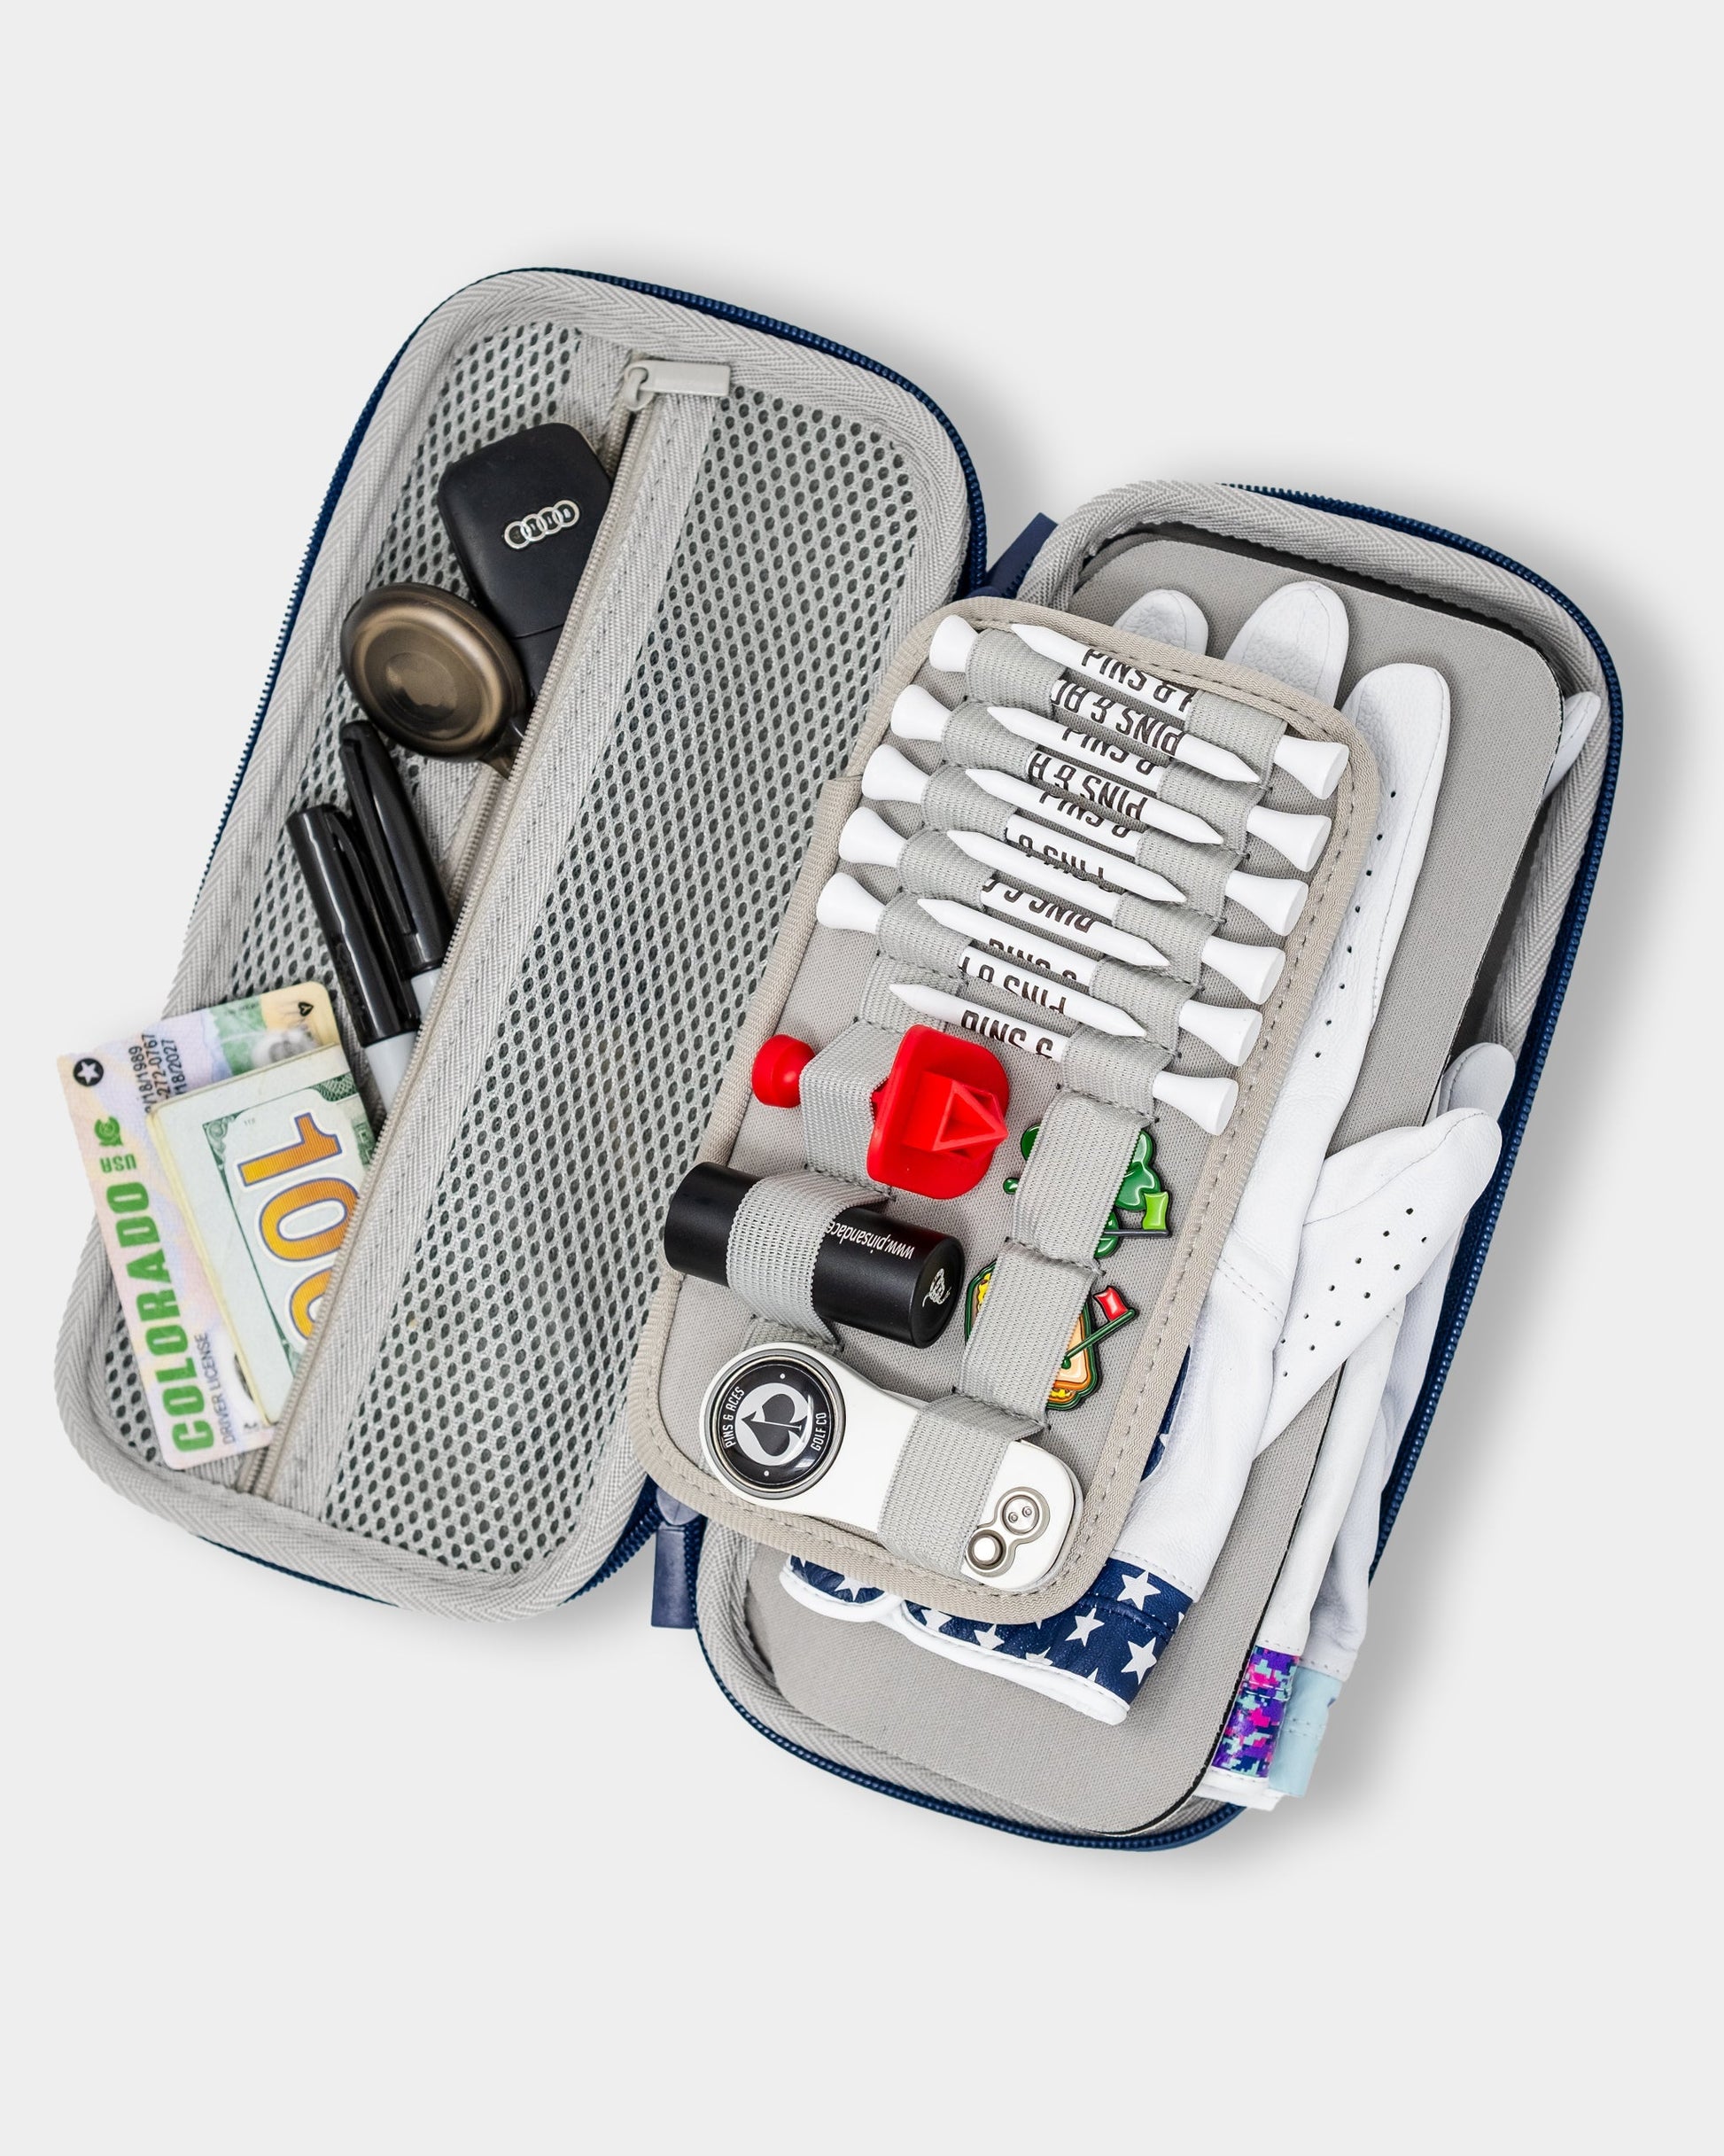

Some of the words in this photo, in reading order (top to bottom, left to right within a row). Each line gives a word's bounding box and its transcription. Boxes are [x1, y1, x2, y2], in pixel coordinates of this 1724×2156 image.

[1115, 708, 1186, 757] PINS
[1080, 774, 1149, 821] PINS
[98, 1153, 137, 1173] USA
[106, 1181, 214, 1453] COLORADO
[193, 1332, 221, 1391] LICENSE
[725, 1386, 746, 1413] ACES
[211, 1393, 237, 1445] DRIVER
[722, 1424, 736, 1450] PINS
[815, 1412, 828, 1425] CO
[810, 1428, 828, 1452] GOLF
